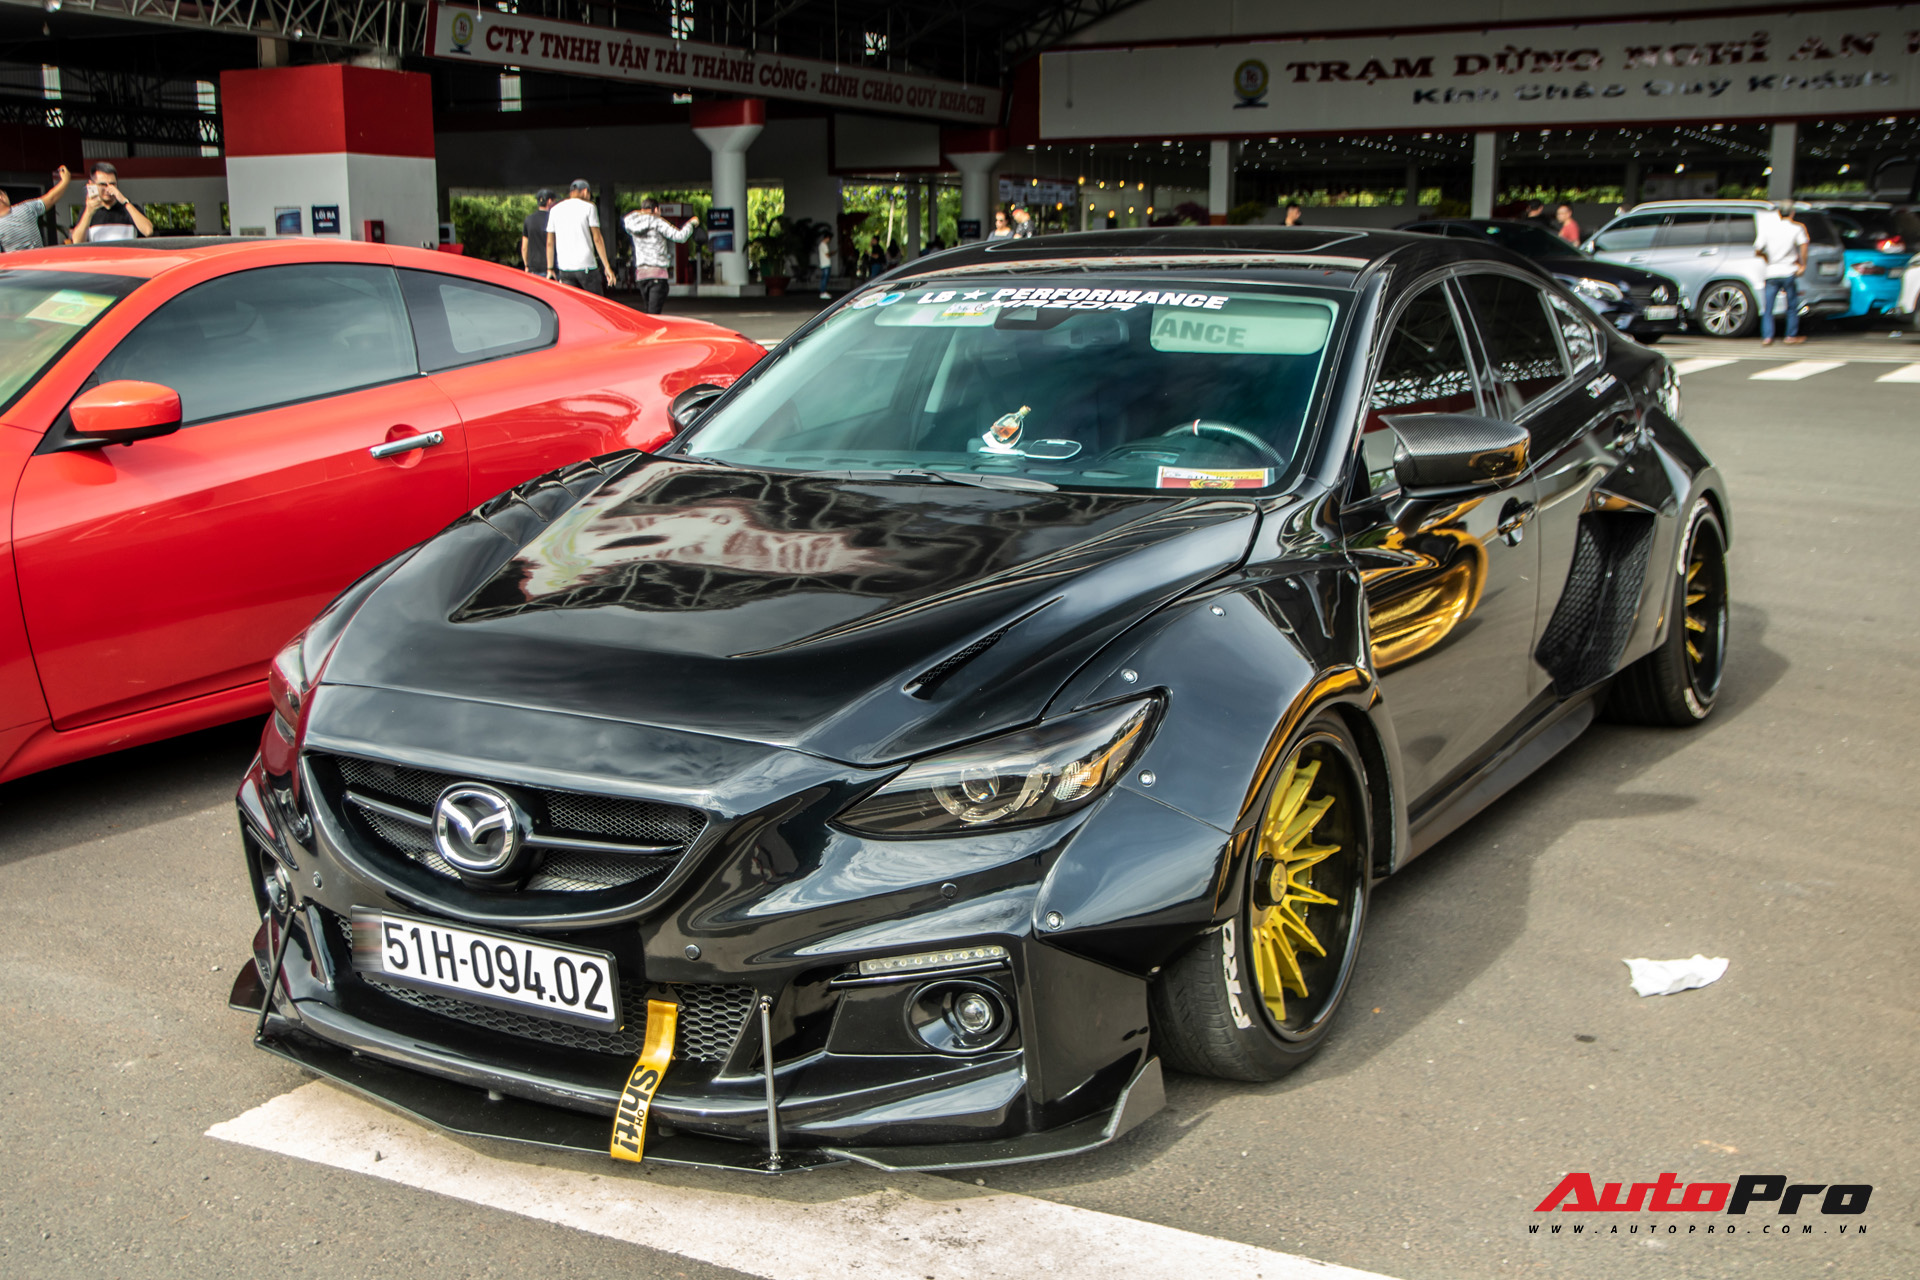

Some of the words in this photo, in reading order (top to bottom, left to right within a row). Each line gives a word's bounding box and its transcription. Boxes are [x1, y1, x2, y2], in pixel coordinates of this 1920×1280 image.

[486, 25, 534, 55] CTY
[540, 32, 601, 64] TNHH
[607, 38, 650, 74] VẬN
[758, 60, 808, 92] CÔNG
[1285, 56, 1435, 85] TRẠM
[917, 291, 957, 304] LB
[991, 288, 1229, 310] PERFORMANCE
[383, 921, 608, 1014] 51H-094.02
